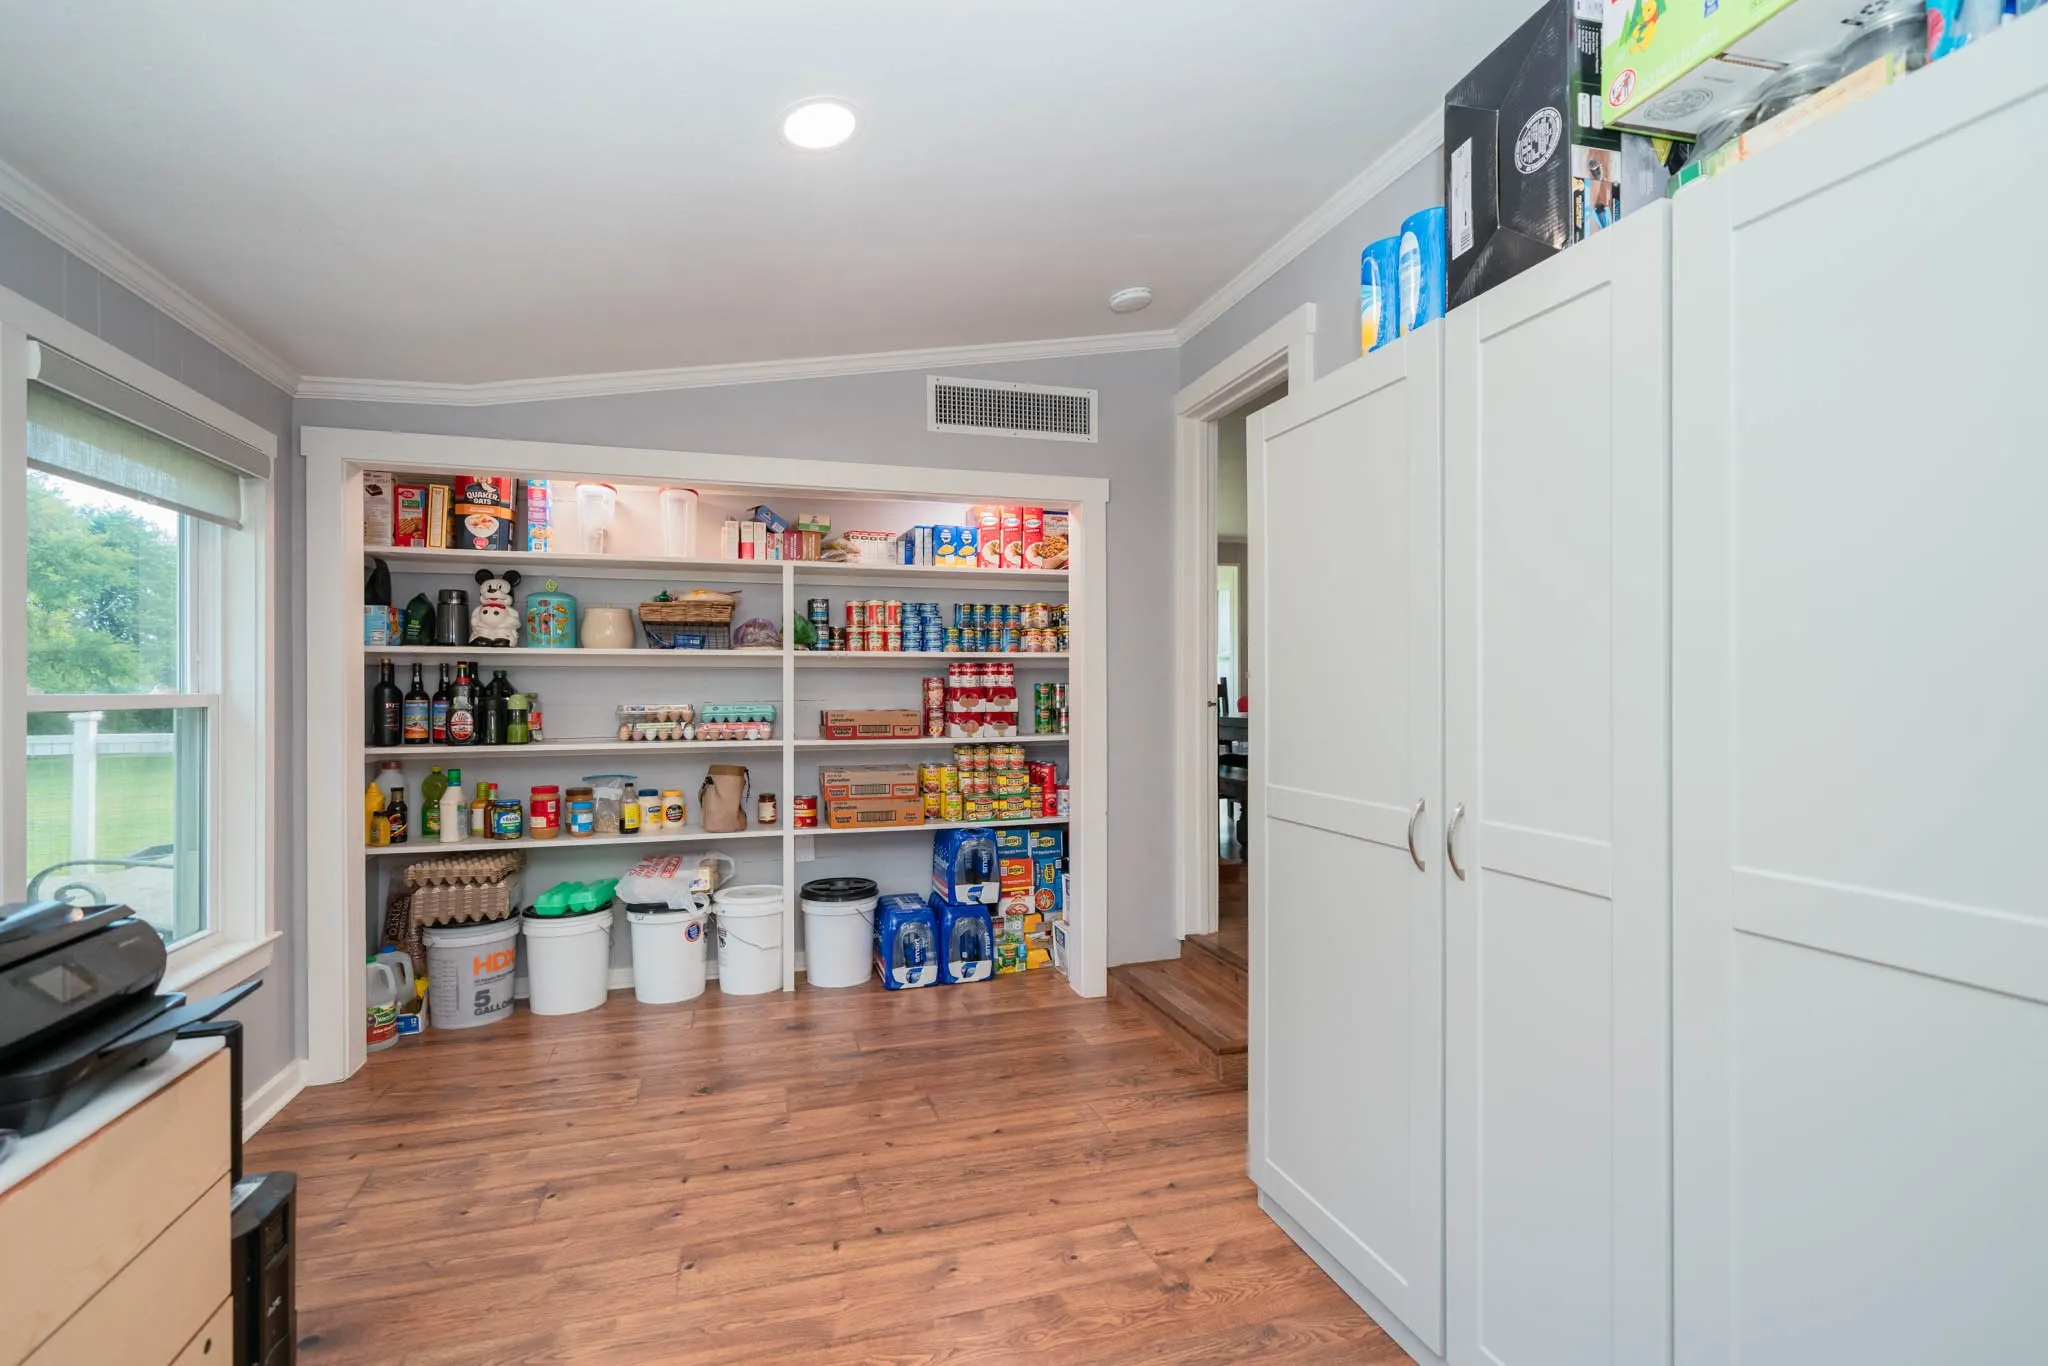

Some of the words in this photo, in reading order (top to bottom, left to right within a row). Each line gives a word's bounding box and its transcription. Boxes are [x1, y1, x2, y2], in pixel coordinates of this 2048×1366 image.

[466, 491, 498, 500] QUAKER
[389, 900, 403, 936] PINTO
[474, 989, 491, 1007] 5
